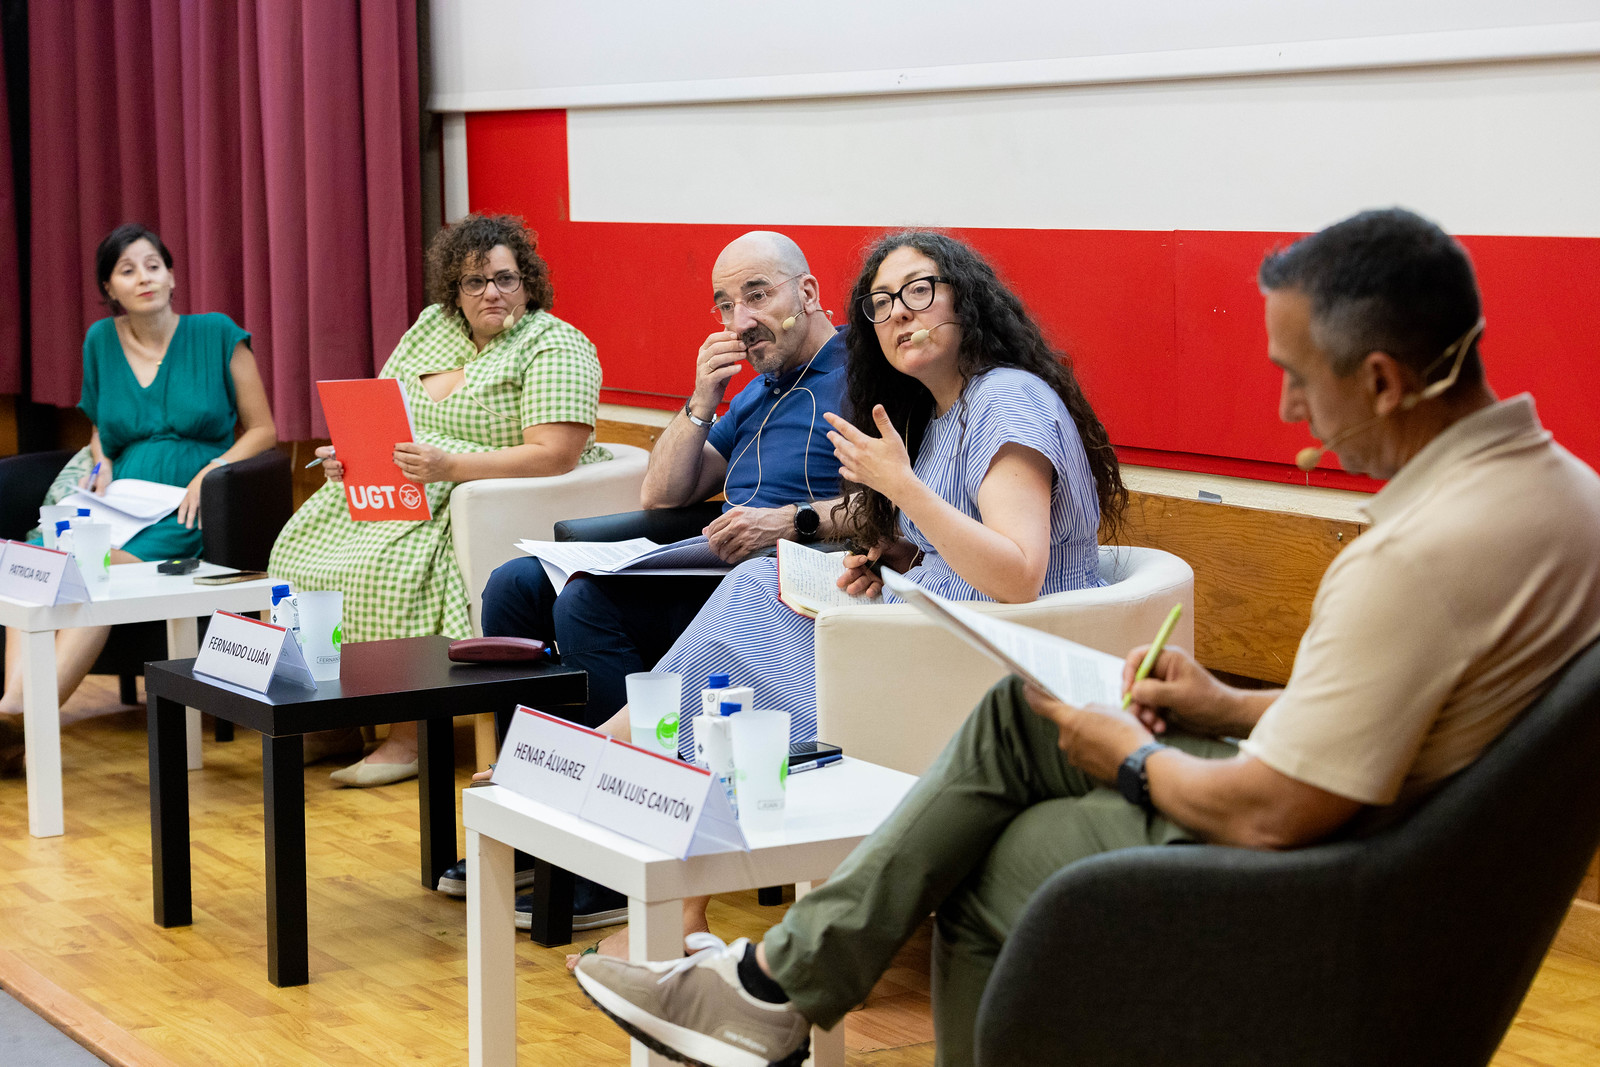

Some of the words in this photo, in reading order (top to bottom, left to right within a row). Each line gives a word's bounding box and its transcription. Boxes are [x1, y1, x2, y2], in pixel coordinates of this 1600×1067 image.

[349, 485, 395, 509] UGT
[9, 564, 34, 579] PATRICIA
[35, 569, 51, 583] RUIZ
[208, 636, 248, 659] FERNANDO
[247, 648, 271, 666] LUJÁN
[514, 741, 546, 767] HENAR
[546, 749, 586, 781] ÁLVAREZ
[596, 773, 624, 796] JUAN
[624, 782, 648, 806] LUIS
[647, 791, 694, 823] CANTÓN
